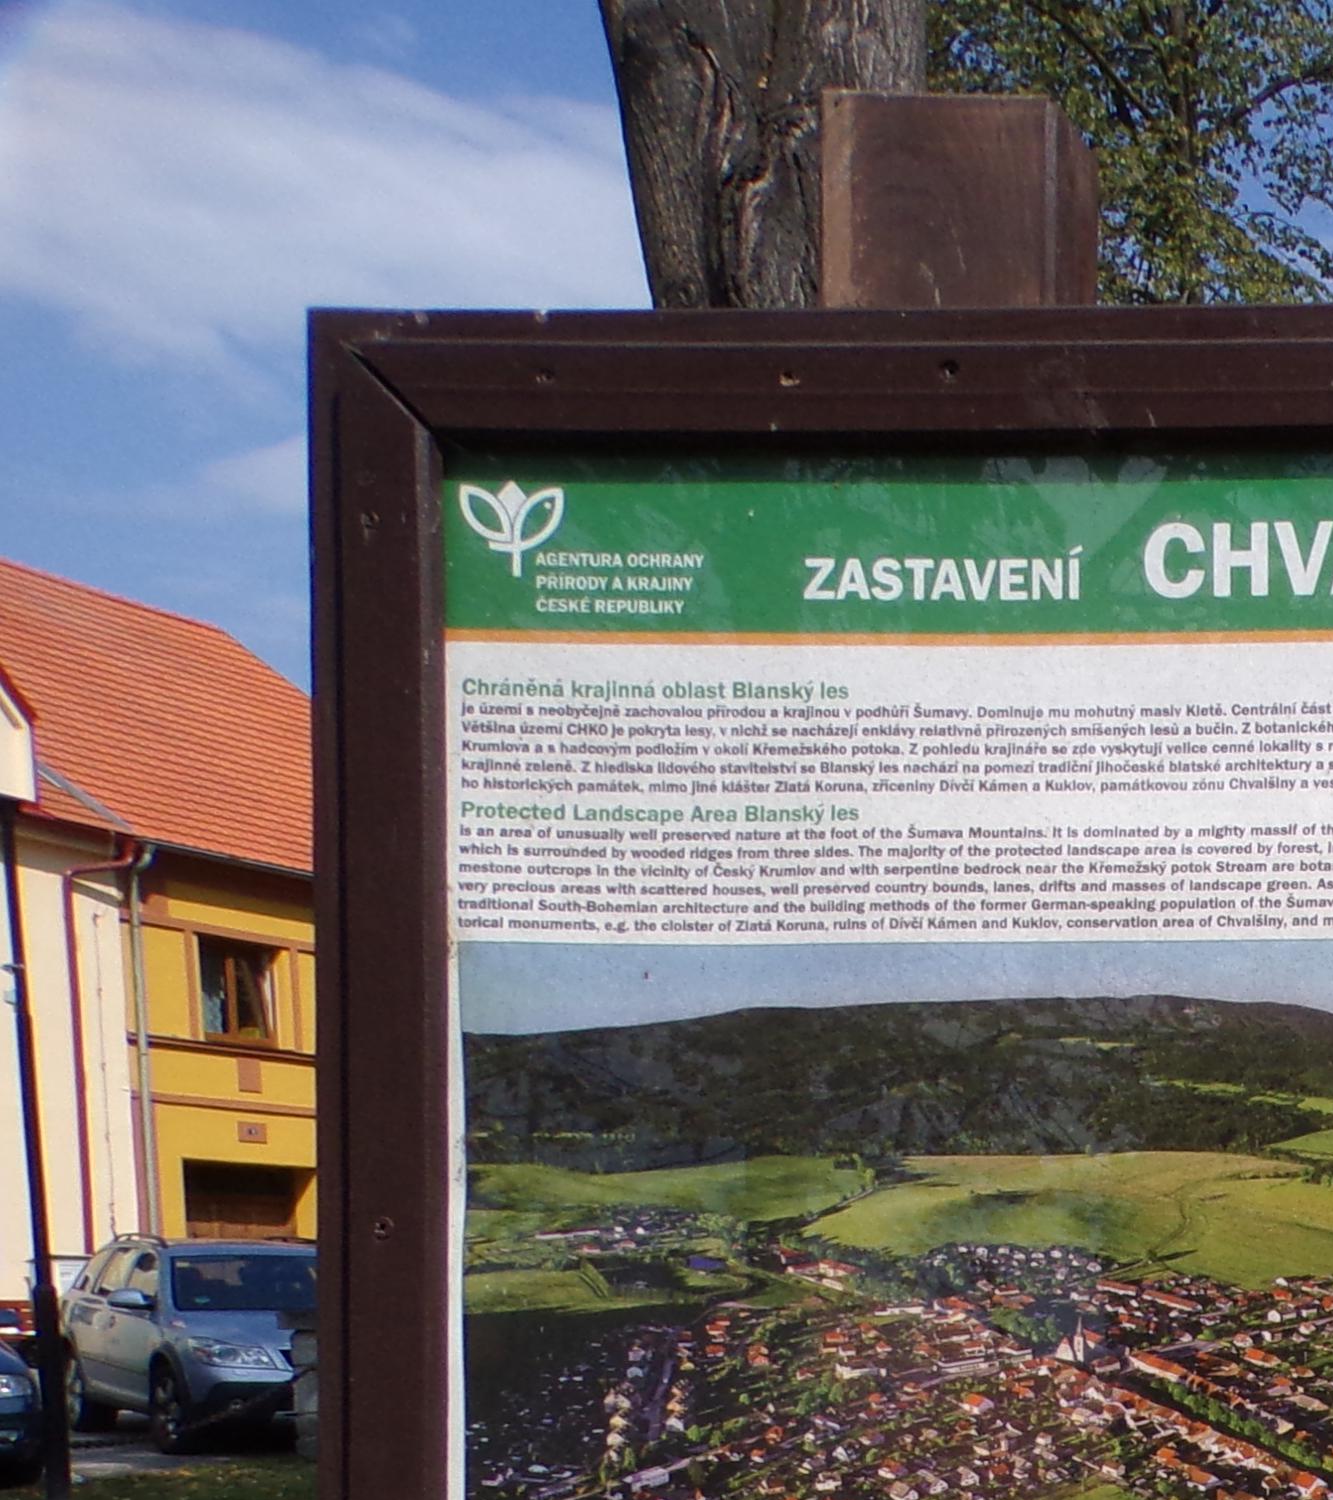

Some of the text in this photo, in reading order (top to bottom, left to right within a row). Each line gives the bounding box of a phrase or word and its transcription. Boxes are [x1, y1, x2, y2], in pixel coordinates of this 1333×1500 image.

[535, 551, 704, 568] AGENTURA OCHRANY
[535, 571, 608, 590] PŘÍRODY
[625, 575, 693, 591] KRAJINY
[803, 545, 1083, 601] ZASTAVENÍ
[534, 595, 684, 614] ČESKÉ REPUBLIKY
[460, 677, 849, 703] Chráněná krajinná oblast Blanský les
[460, 800, 859, 825] Protected Landscape Area Blanský les
